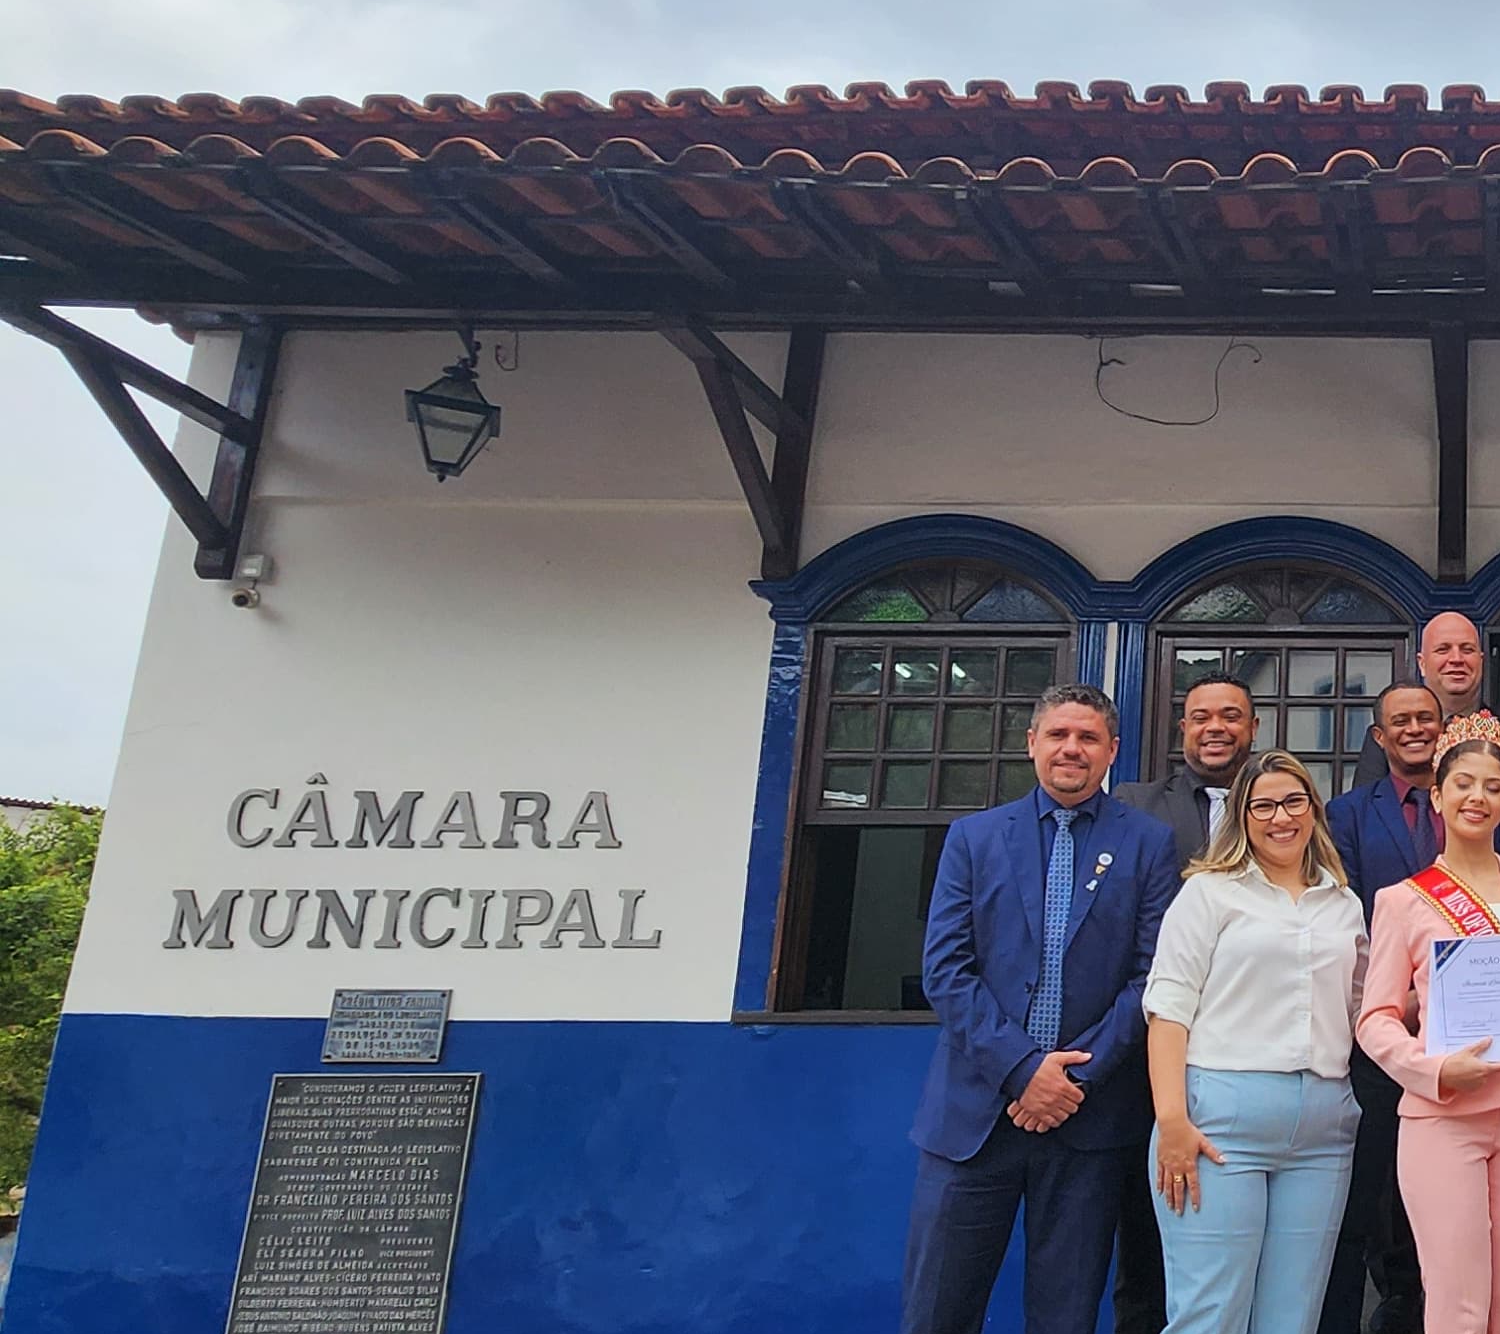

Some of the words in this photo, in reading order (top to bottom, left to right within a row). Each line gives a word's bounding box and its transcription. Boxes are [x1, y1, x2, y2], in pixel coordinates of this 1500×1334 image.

[226, 771, 622, 849] CÂMARA
[1440, 889, 1475, 917] MISS
[162, 886, 662, 949] MUNICIPAL
[1469, 954, 1500, 966] MOÇÃO
[409, 1083, 461, 1092] LEGISLATIVO
[365, 1096, 396, 1104] DENTRE
[399, 1096, 411, 1104] AS
[426, 1107, 451, 1116] ACIMA
[455, 1107, 466, 1116] DE
[397, 1117, 414, 1128] SÃO
[417, 1119, 464, 1127] DERIVADAS
[268, 1131, 329, 1139] DIRETAMENTE
[291, 1145, 313, 1154] ESTA
[315, 1145, 338, 1154] CASA
[340, 1145, 389, 1154] DESTINADA
[391, 1145, 403, 1154] AO
[406, 1145, 461, 1154] LEGISLATIVO
[323, 1157, 339, 1166] FOI
[405, 1157, 429, 1165] PELA
[349, 1169, 405, 1180] MARCELO
[409, 1169, 439, 1180] DIAS
[273, 1194, 338, 1205] FRANCELINO
[341, 1194, 387, 1205] PEREIRA
[390, 1193, 411, 1205] DOS
[413, 1193, 453, 1205] SANTOS
[346, 1209, 365, 1220] LUIZ
[367, 1209, 394, 1220] ALVES
[396, 1209, 415, 1220] DOS
[416, 1209, 450, 1220] SANTOS
[297, 1236, 332, 1245] LEITE
[330, 1248, 364, 1258] FILHO
[253, 1261, 275, 1270] LUIZ
[316, 1261, 329, 1270] DE
[332, 1261, 373, 1270] ALMEIDA
[370, 1273, 413, 1281] FERREIRA
[416, 1273, 441, 1281] PINTO
[239, 1286, 286, 1295] FRANCISCO
[322, 1286, 339, 1295] DOS
[417, 1285, 439, 1294] SILVA
[372, 1322, 405, 1331] BATISTA
[407, 1322, 433, 1331] ALVES
